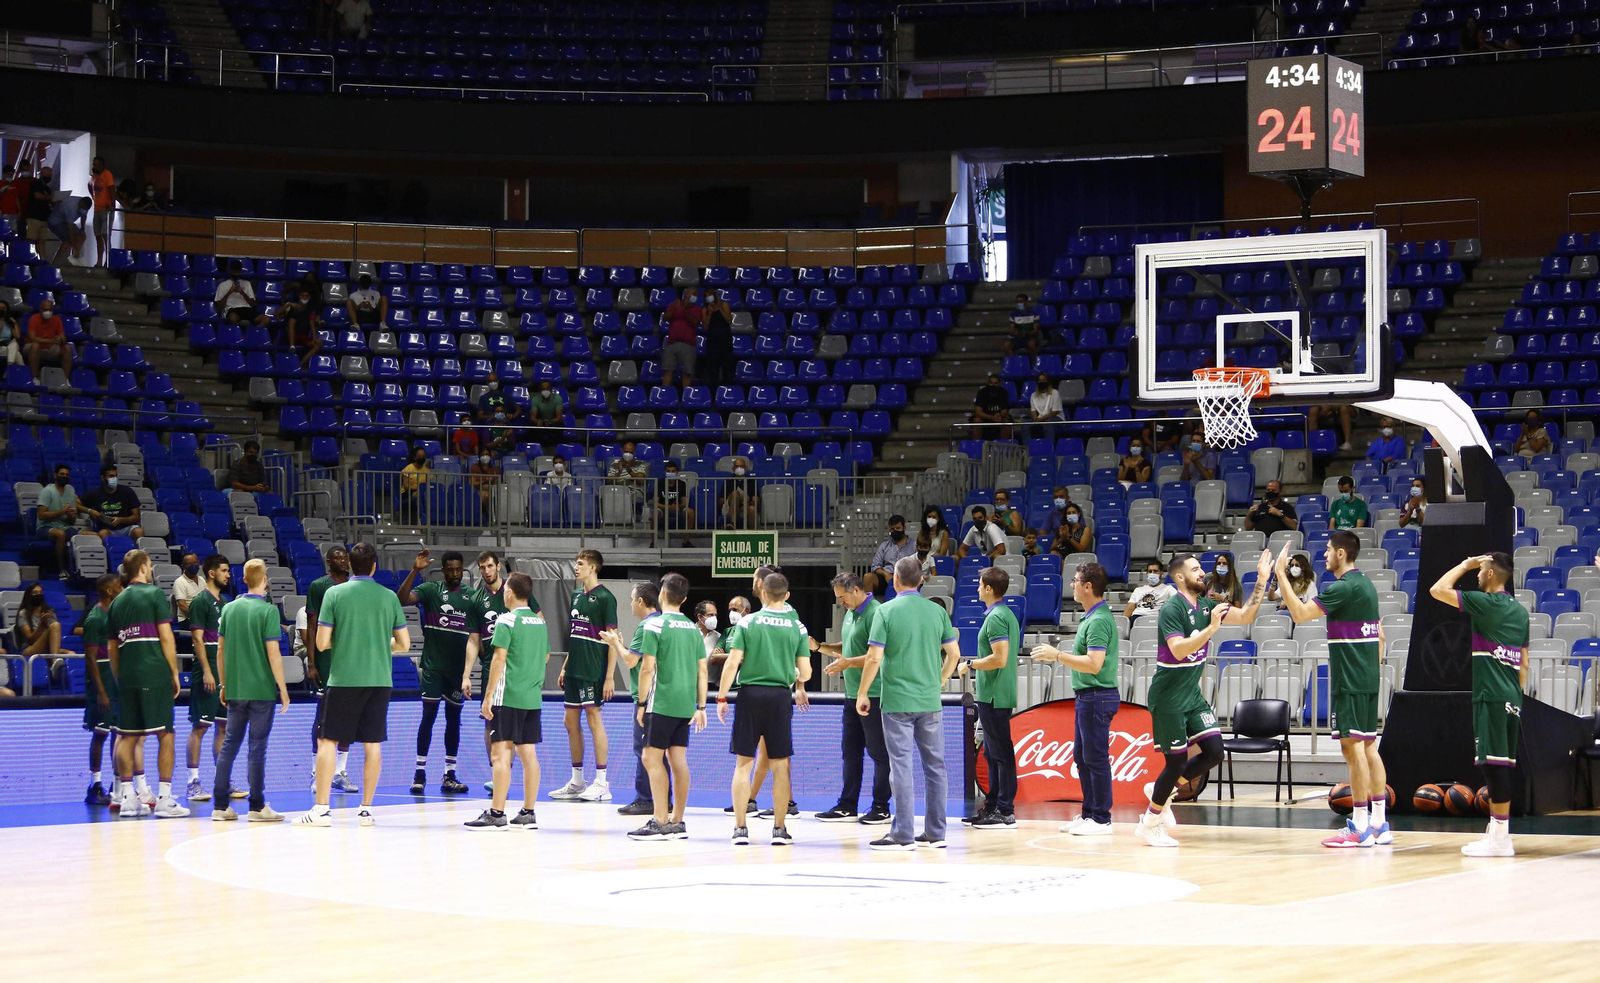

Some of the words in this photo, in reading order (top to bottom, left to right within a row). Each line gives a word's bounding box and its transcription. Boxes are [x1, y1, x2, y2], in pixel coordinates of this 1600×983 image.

[1265, 63, 1320, 88] 4:34
[1335, 66, 1362, 94] 4:34
[1257, 105, 1316, 153] 24
[1332, 107, 1361, 157] 24
[720, 541, 752, 554] SALIDA
[758, 541, 769, 554] DE
[716, 556, 772, 569] EMERGENCIA
